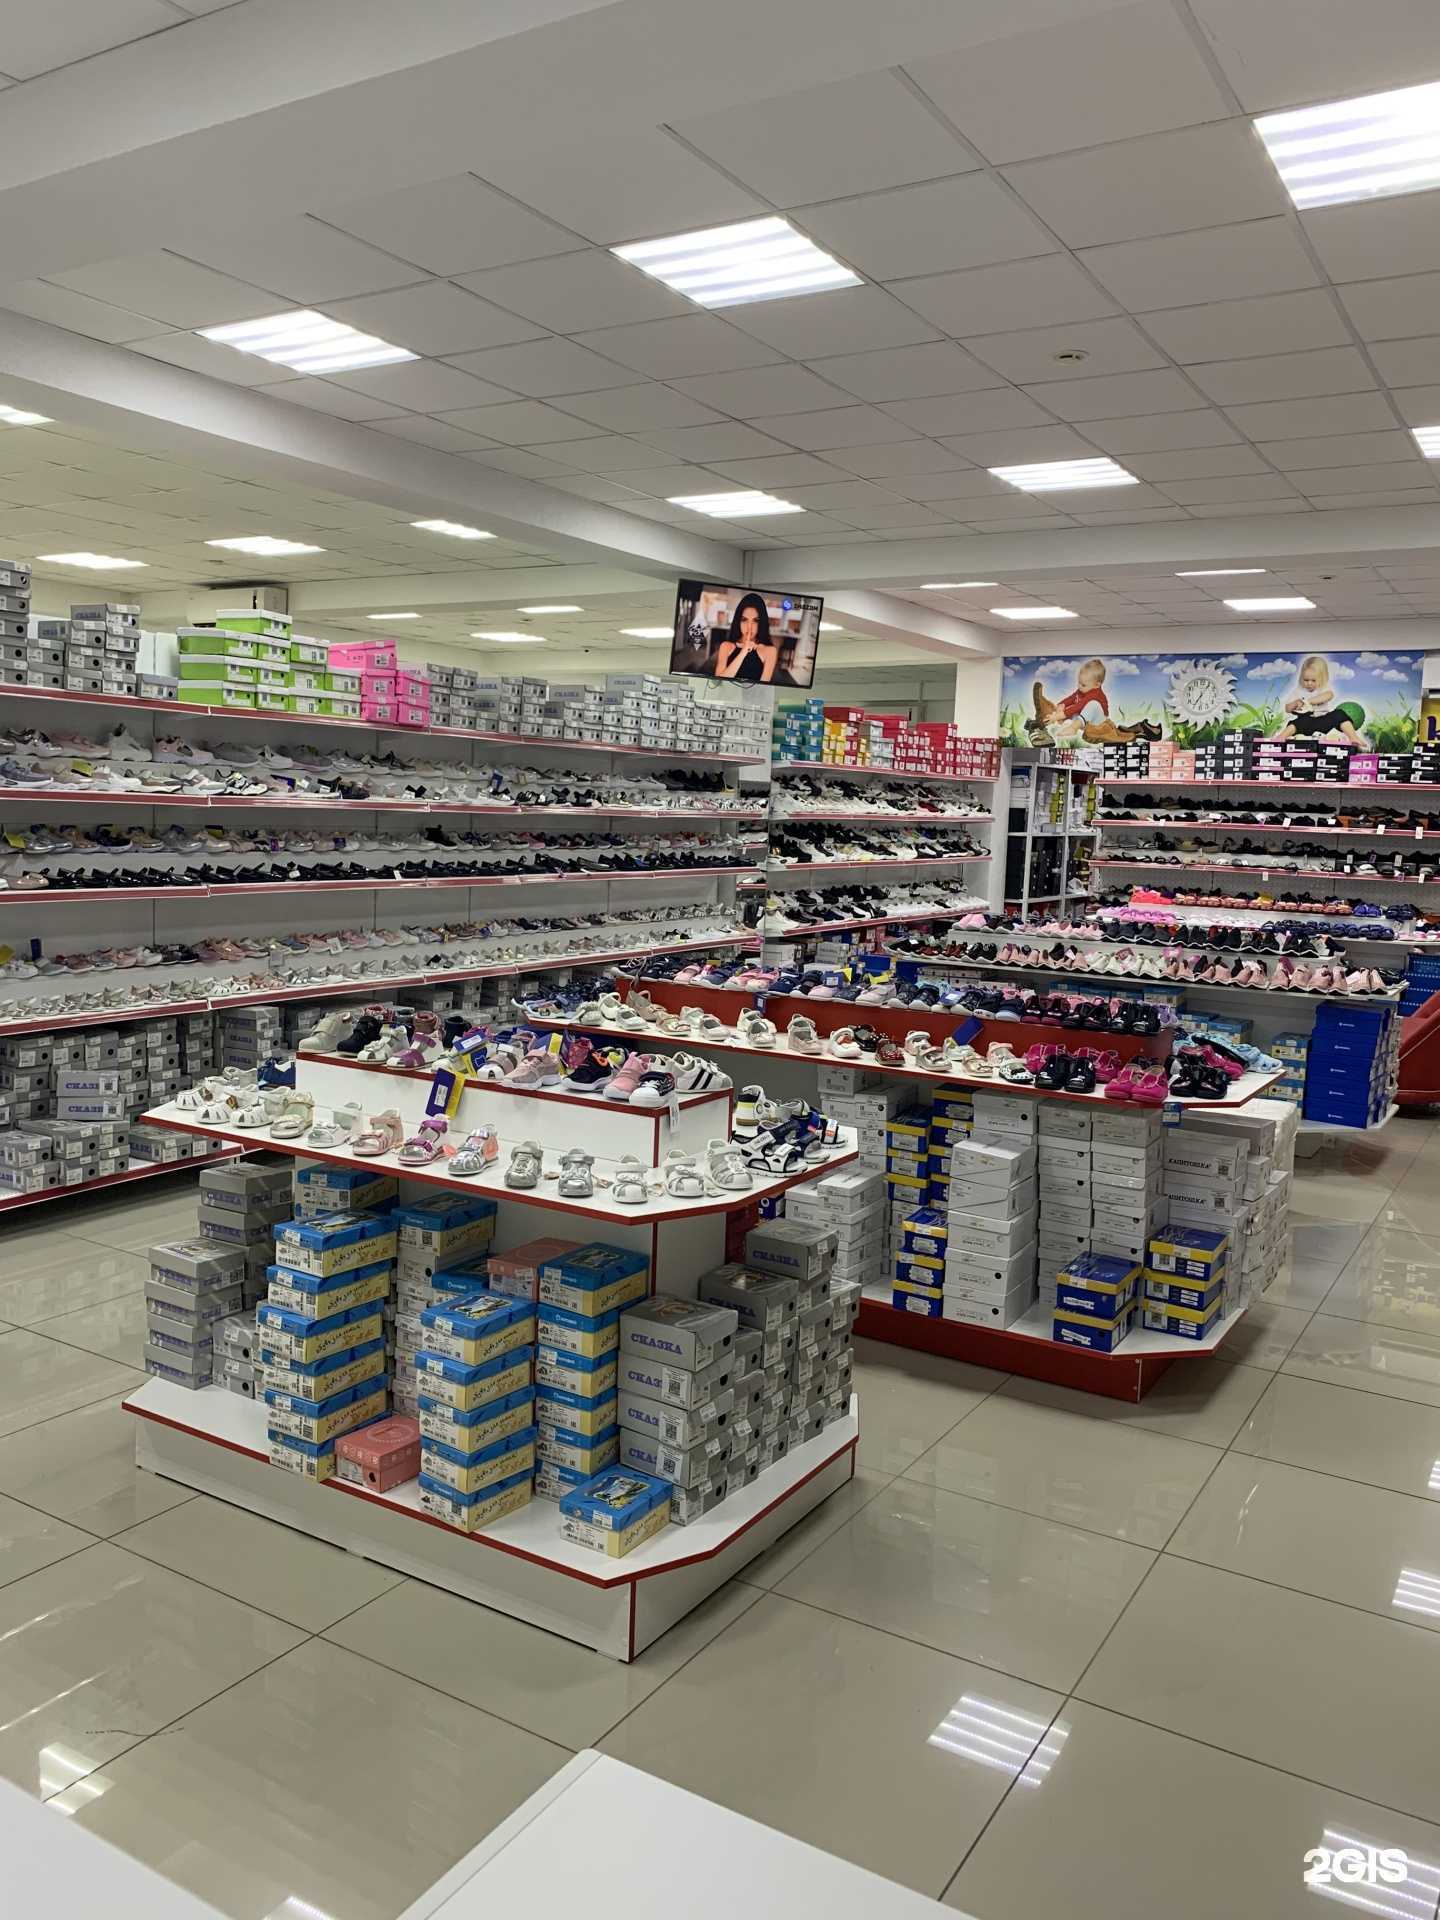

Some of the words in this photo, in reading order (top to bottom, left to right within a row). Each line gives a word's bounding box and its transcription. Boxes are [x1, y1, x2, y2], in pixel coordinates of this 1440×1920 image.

[630, 1333, 683, 1355] СКАЗКА
[628, 1370, 662, 1388] СКАЗ
[628, 1408, 658, 1426] СКАЗ
